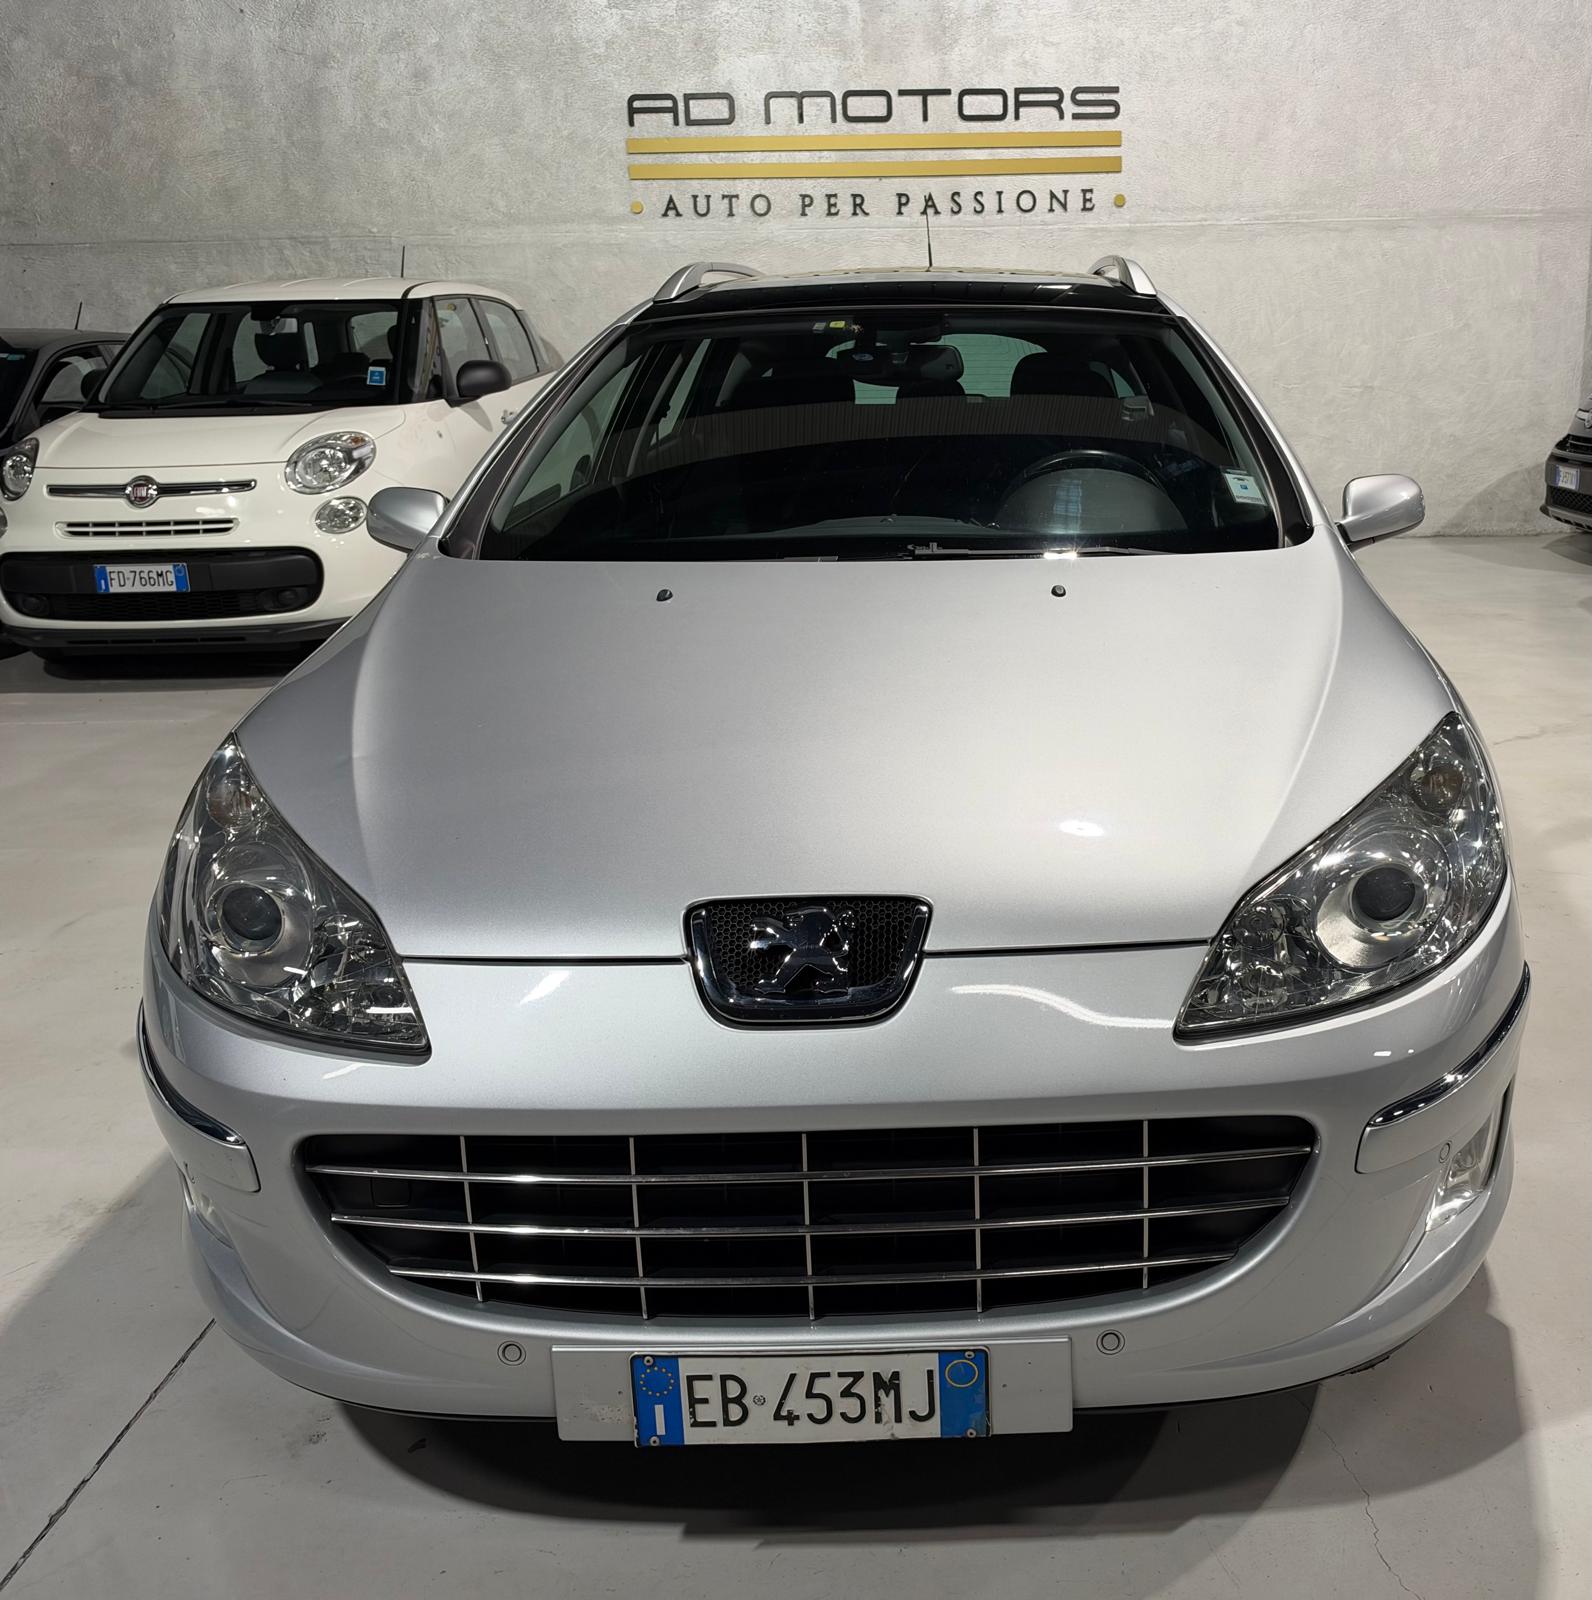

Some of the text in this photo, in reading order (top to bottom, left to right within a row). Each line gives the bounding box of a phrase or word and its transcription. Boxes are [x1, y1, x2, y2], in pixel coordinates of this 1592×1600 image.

[628, 86, 1121, 126] AD MOTORS
[661, 188, 1096, 217] AUTO PER PASSIONE
